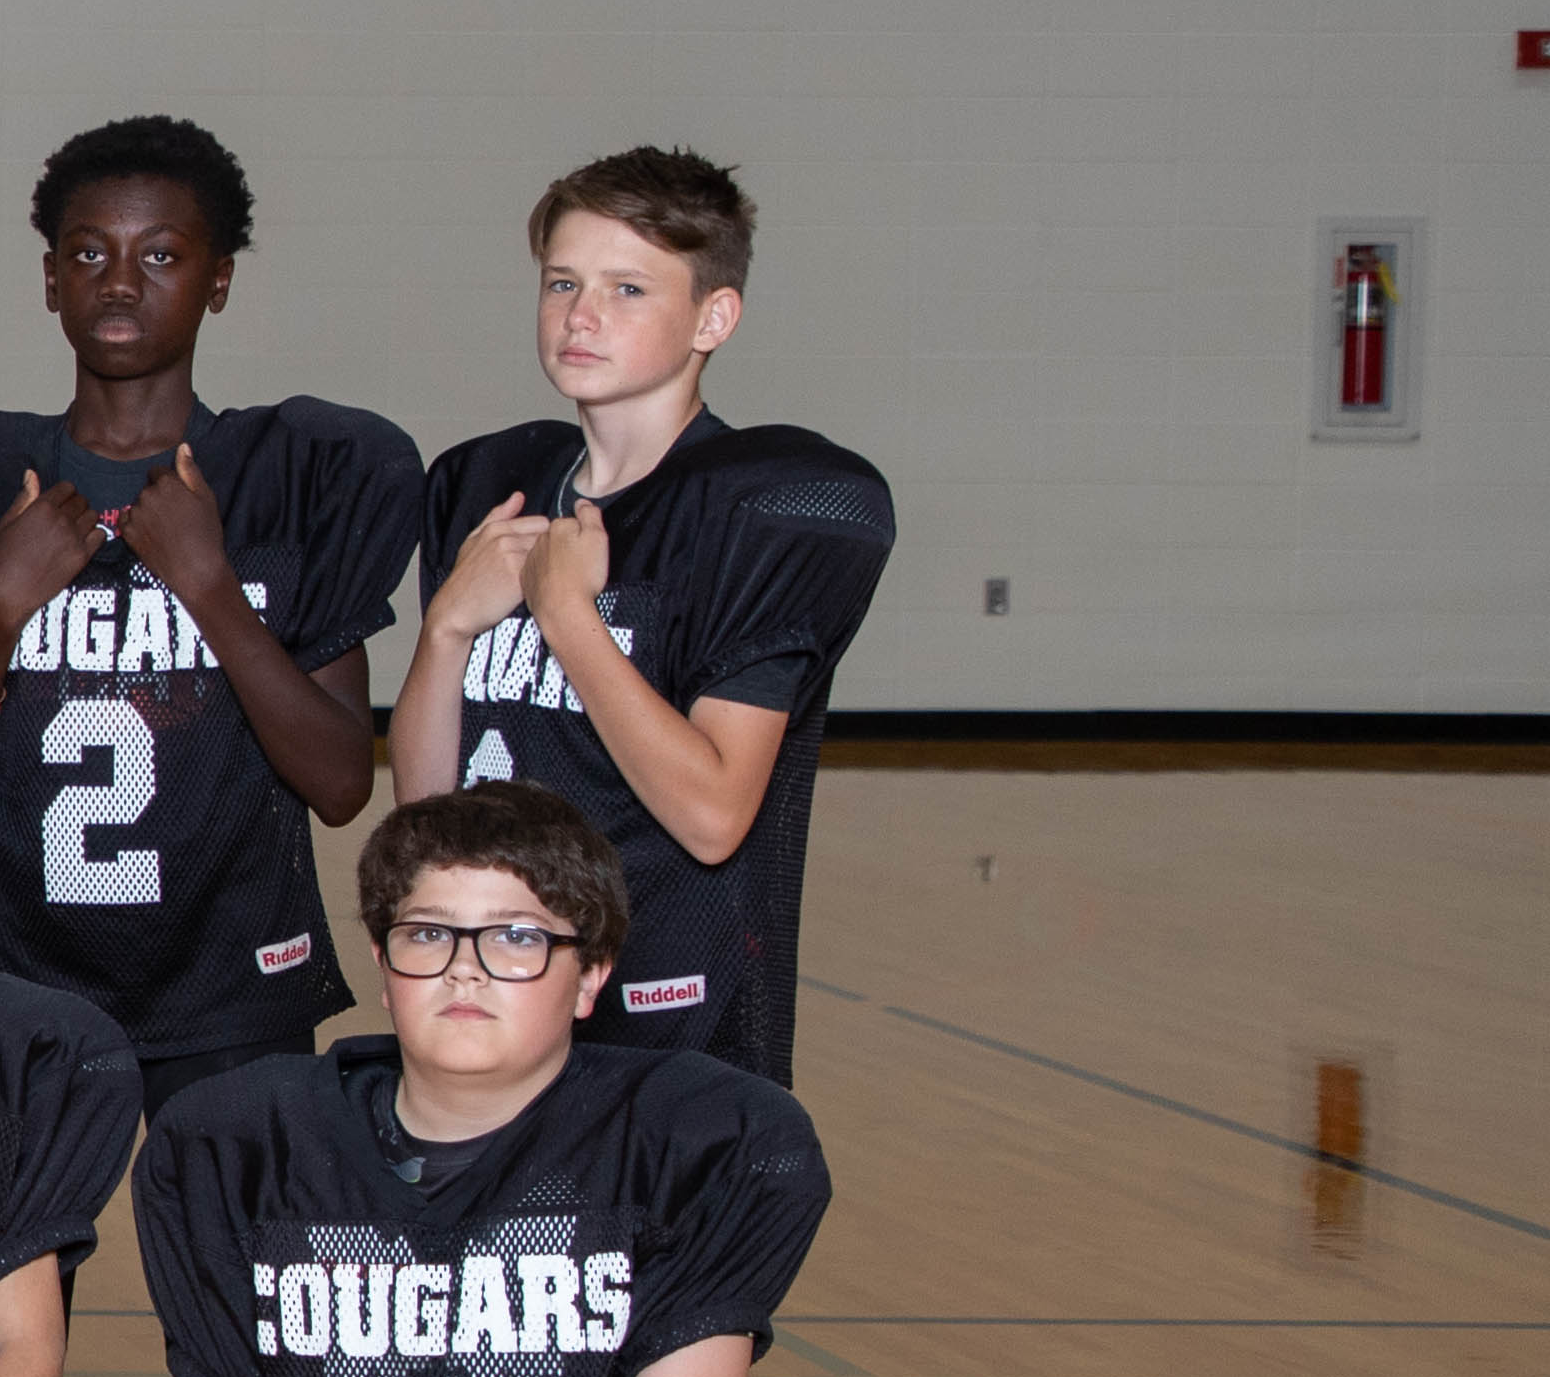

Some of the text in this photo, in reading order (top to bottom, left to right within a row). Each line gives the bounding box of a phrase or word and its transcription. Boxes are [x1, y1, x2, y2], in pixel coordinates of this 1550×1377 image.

[41, 699, 162, 904] 2
[629, 982, 699, 1007] Riddell
[253, 1251, 634, 1358] COUGARS
